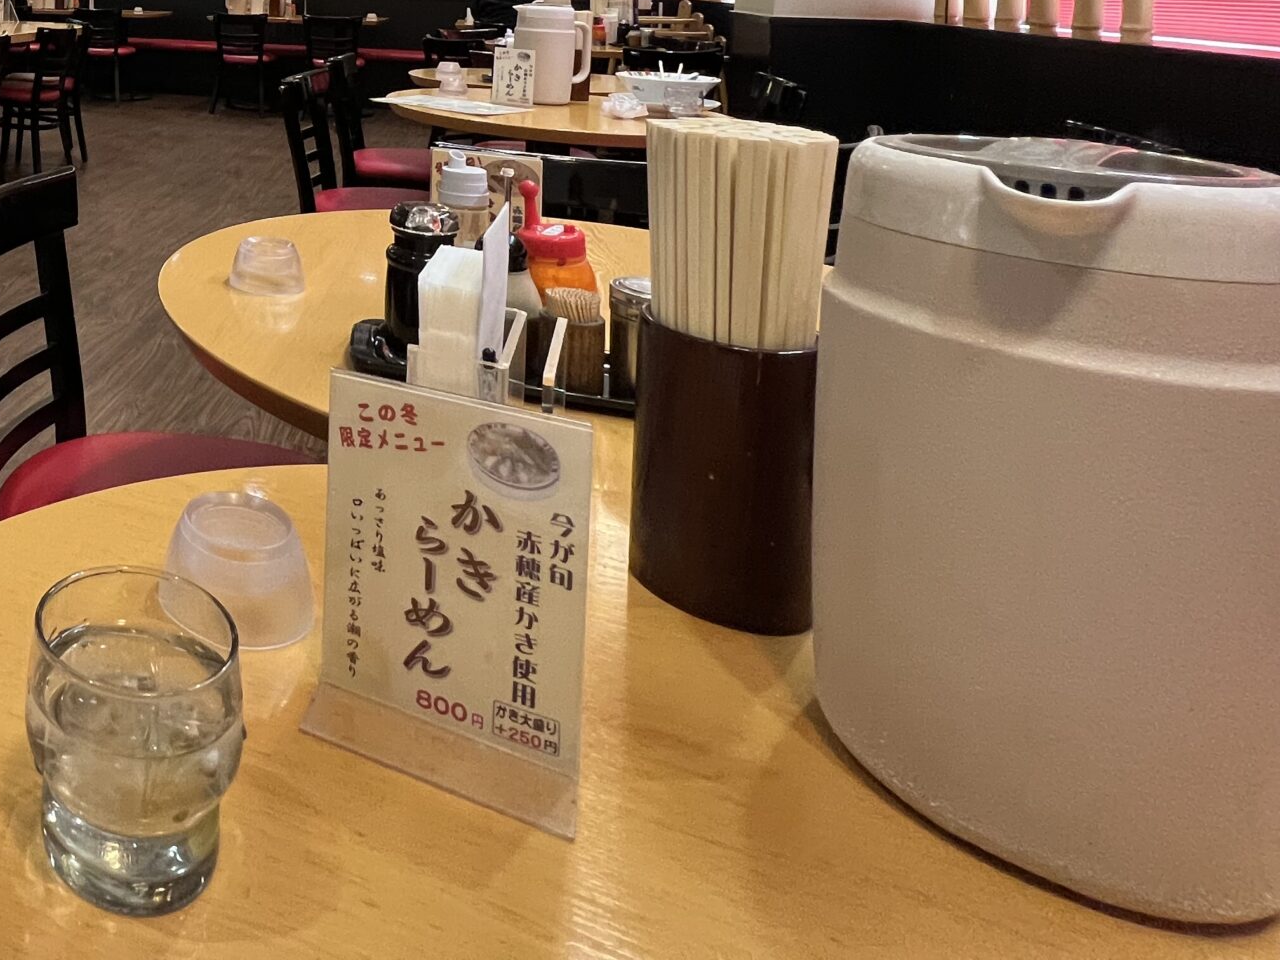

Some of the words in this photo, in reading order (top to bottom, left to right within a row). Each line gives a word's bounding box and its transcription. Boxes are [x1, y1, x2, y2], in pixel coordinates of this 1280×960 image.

[338, 426, 446, 452] 限定メニュー
[357, 403, 418, 426] この冬
[371, 488, 386, 573] あっさり塩味
[450, 489, 504, 603] かき
[548, 512, 576, 591] 今が旬
[402, 515, 454, 679] らーめん
[511, 530, 542, 709] 赤穂産かき使用
[415, 689, 484, 730] 800円
[494, 723, 558, 755] +250円
[495, 704, 557, 736] かき大盛り
